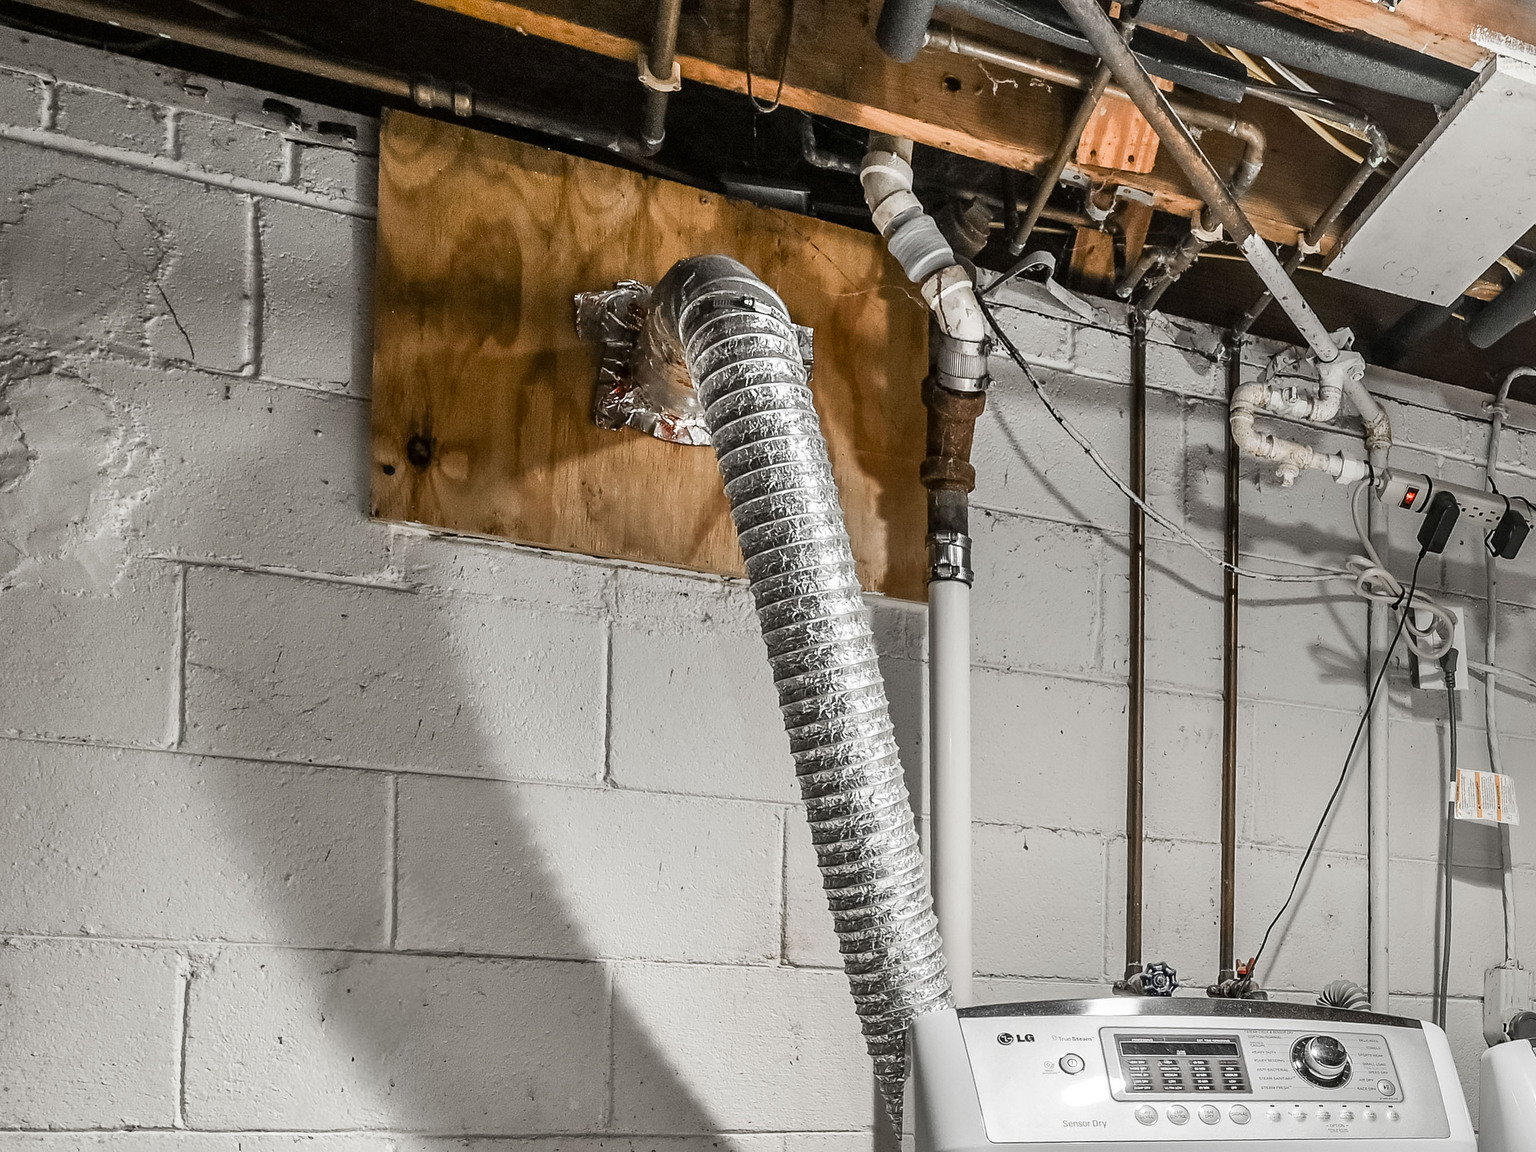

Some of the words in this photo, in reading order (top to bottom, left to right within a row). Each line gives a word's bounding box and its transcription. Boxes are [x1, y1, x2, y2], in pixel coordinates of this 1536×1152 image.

[1016, 1033, 1036, 1042] LG
[1062, 1120, 1091, 1128] Sensor
[1092, 1120, 1107, 1129] Dry
